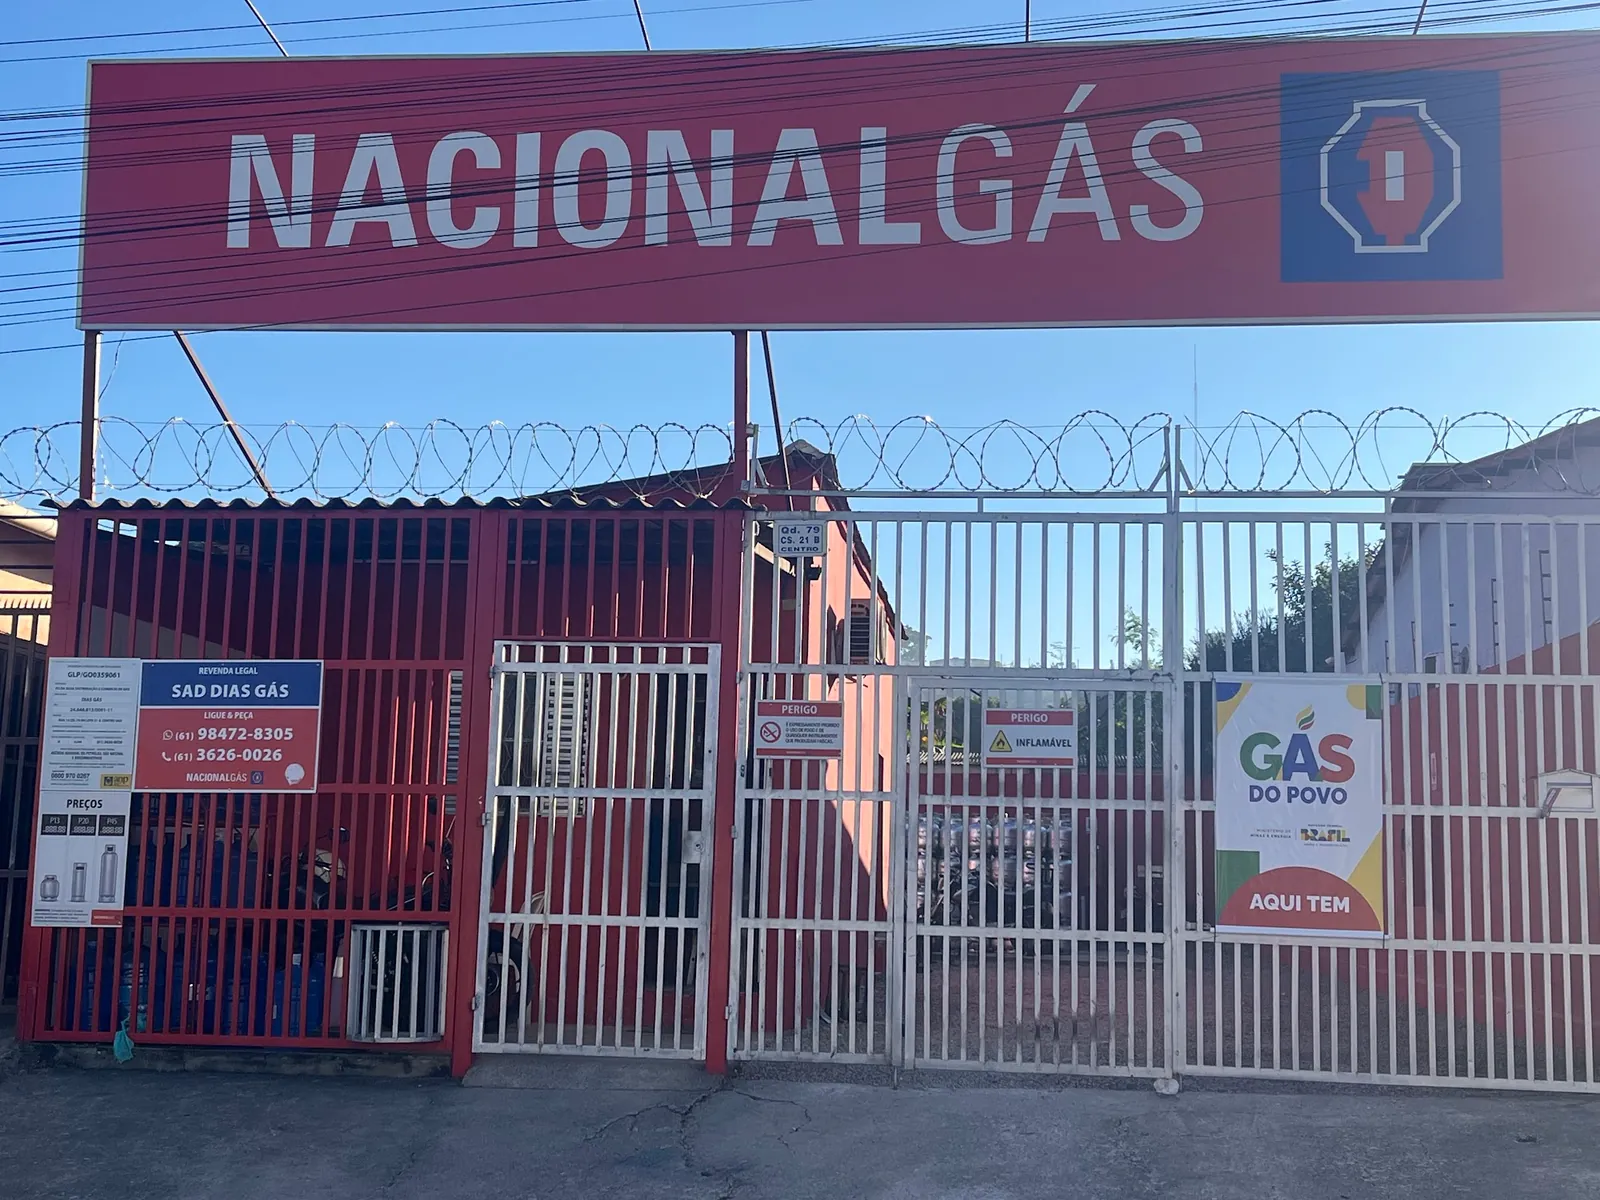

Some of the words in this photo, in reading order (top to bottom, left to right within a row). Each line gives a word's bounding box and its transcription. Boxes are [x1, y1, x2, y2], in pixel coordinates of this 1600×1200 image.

[781, 526, 800, 534] Qd.
[806, 526, 820, 534] 79
[780, 536, 796, 544] CS.
[799, 536, 809, 544] 21
[813, 536, 820, 544] B
[198, 667, 234, 675] REVENDA
[234, 667, 258, 675] LEGAL
[171, 684, 206, 698] SAD
[210, 684, 250, 698] DIAS
[254, 681, 289, 698] GÁS
[781, 704, 817, 714] PERIGO
[204, 711, 226, 719] LIGUE
[227, 711, 233, 719] &
[234, 711, 254, 721] PEÇA
[1011, 713, 1048, 723] PERIGO
[175, 731, 194, 741] (61)
[197, 727, 294, 741] 98472-8305
[1016, 737, 1072, 748] INFLAMÁVEL
[1240, 704, 1355, 783] GÁS
[174, 752, 193, 762] (61)
[196, 748, 283, 761] 3626-0026
[1249, 785, 1281, 803] DO
[1287, 786, 1348, 805] POVO
[66, 799, 103, 811] PREÇOS
[1300, 828, 1350, 842] BRASIL
[1250, 893, 1301, 911] AQUI
[1306, 895, 1350, 913] TEM
